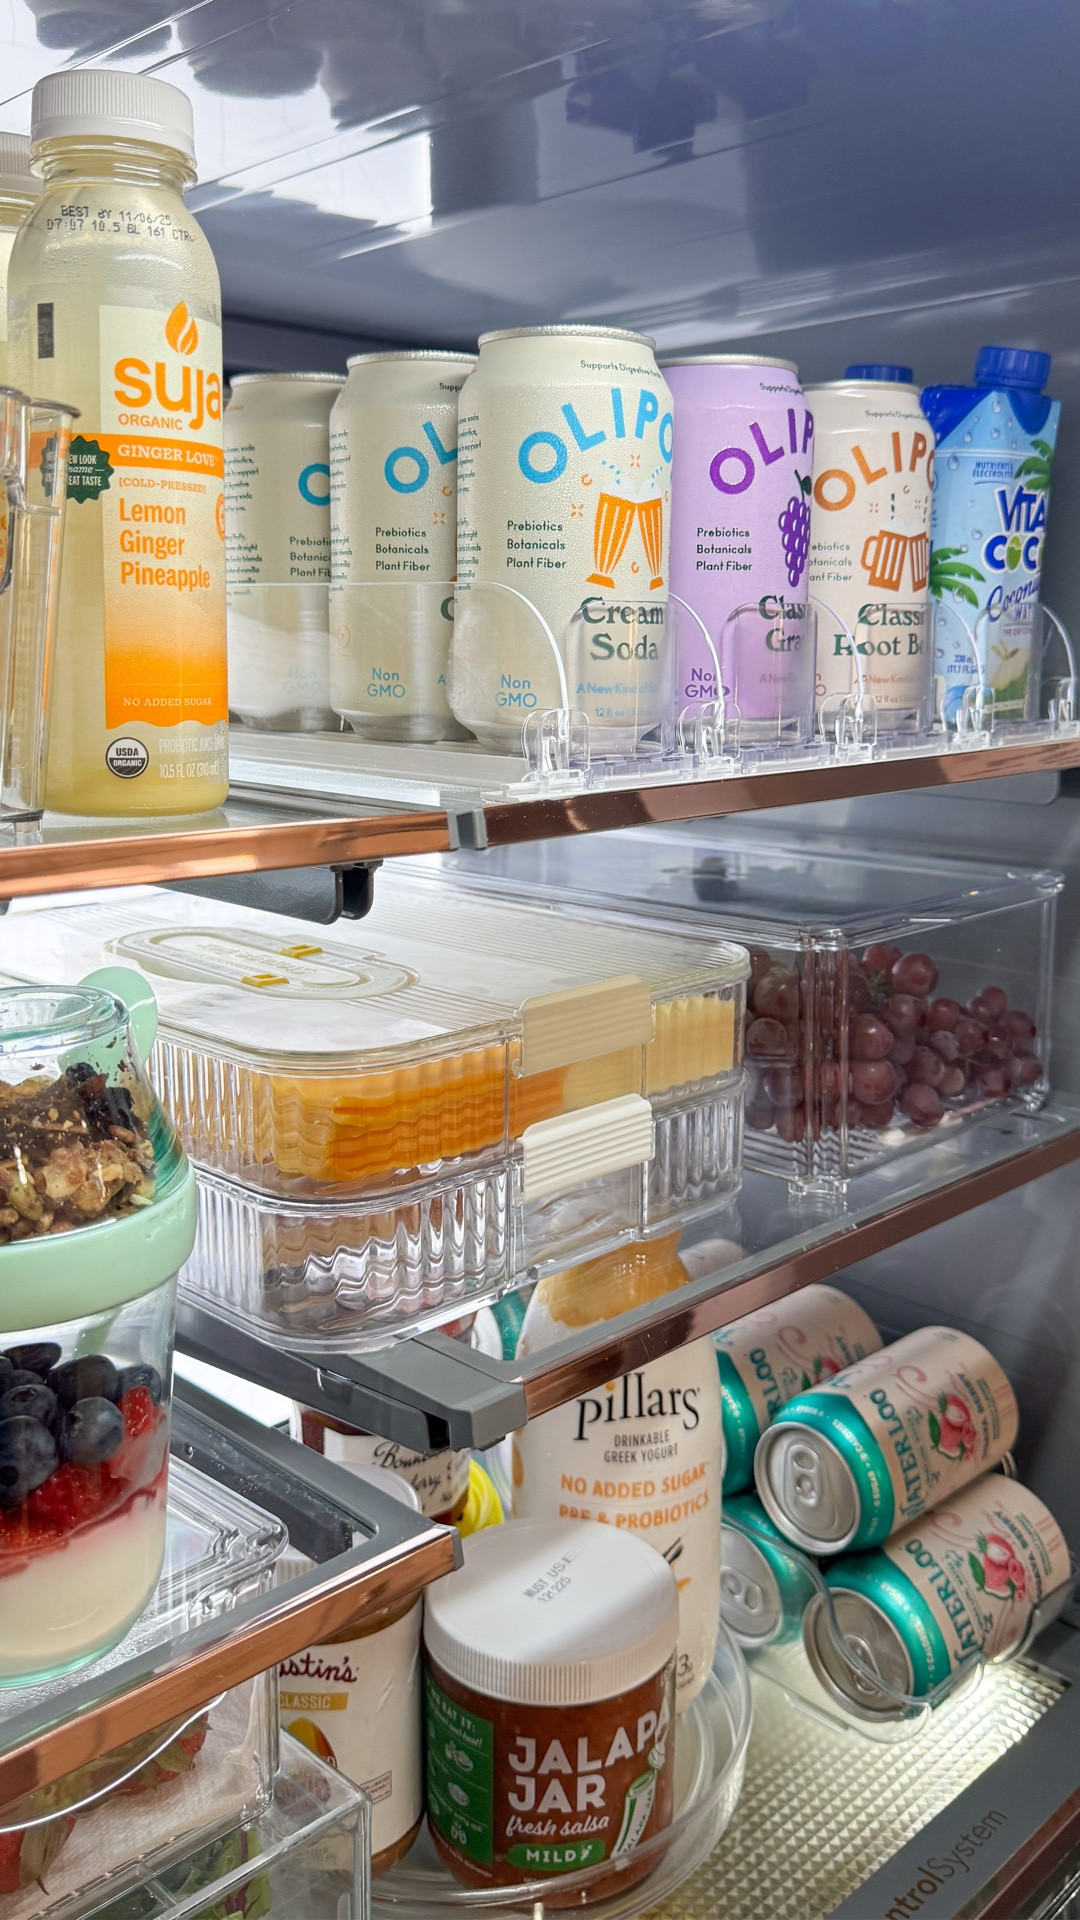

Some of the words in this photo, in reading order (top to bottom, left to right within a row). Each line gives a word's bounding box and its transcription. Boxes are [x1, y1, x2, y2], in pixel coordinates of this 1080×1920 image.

[61, 206, 89, 217] BEST
[98, 208, 112, 219] BY
[120, 211, 172, 226] 11/06/25
[46, 218, 84, 230] 07:07
[92, 220, 120, 232] 10.5
[147, 225, 165, 237] 161
[580, 359, 618, 371] Supports
[114, 357, 221, 430] suja
[118, 413, 183, 431] ORGANIC
[69, 454, 79, 465] EW
[79, 454, 97, 465] LOOK
[117, 444, 182, 462] GINGER
[186, 450, 216, 468] LOVE
[68, 466, 93, 474] same
[68, 476, 80, 487] EAT
[81, 476, 102, 487] TASTE
[118, 478, 207, 494] [COLD-PRESSED]
[118, 498, 187, 525] Lemon
[997, 486, 1045, 533] VITA
[375, 526, 427, 538] Prebiotics
[507, 520, 563, 533] Prebiotics
[697, 527, 750, 539] Prebiotics
[120, 530, 185, 560] Ginger
[375, 543, 430, 555] Botanicals
[507, 538, 566, 552] Botanicals
[696, 544, 753, 555] Botanicals
[811, 541, 850, 552] ebiotics
[375, 560, 401, 571] Plant
[403, 560, 430, 572] Fiber
[506, 557, 535, 569] Plant
[536, 557, 567, 570] Fiber
[696, 561, 724, 572] Plant
[725, 561, 753, 572] Fiber
[121, 561, 211, 592] Pineapple
[290, 567, 316, 577] Plant
[809, 572, 824, 582] ant
[827, 572, 852, 582] Fiber
[581, 596, 664, 624] Cream
[590, 632, 660, 660] Soda
[832, 634, 901, 656] Root
[371, 668, 400, 682] Non
[501, 673, 531, 689] Non
[366, 683, 406, 699] GMO
[587, 682, 613, 694] New
[123, 697, 141, 708] NO
[144, 696, 182, 708] ADDED
[184, 696, 213, 707] SUGAR
[495, 690, 538, 708] GMO
[595, 708, 605, 717] 12
[116, 747, 139, 757] USDA
[113, 759, 143, 767] ORGANIC
[159, 764, 175, 778] 10.5
[176, 763, 185, 778] FL
[186, 763, 196, 777] OZ
[573, 1372, 700, 1441] pillars
[614, 1429, 670, 1446] DRINKABLE
[604, 1449, 638, 1463] GREEK
[642, 1443, 679, 1462] YOGURT
[561, 1474, 587, 1495] NO
[592, 1481, 655, 1498] ADDED
[661, 1463, 706, 1494] SUGAR
[615, 1490, 709, 1530] PROBIOTICS
[522, 1578, 549, 1598] MUST
[508, 1774, 606, 1814] JAR
[506, 1816, 556, 1837] fresh
[560, 1815, 610, 1836] salsa
[526, 1848, 577, 1863] MILD
